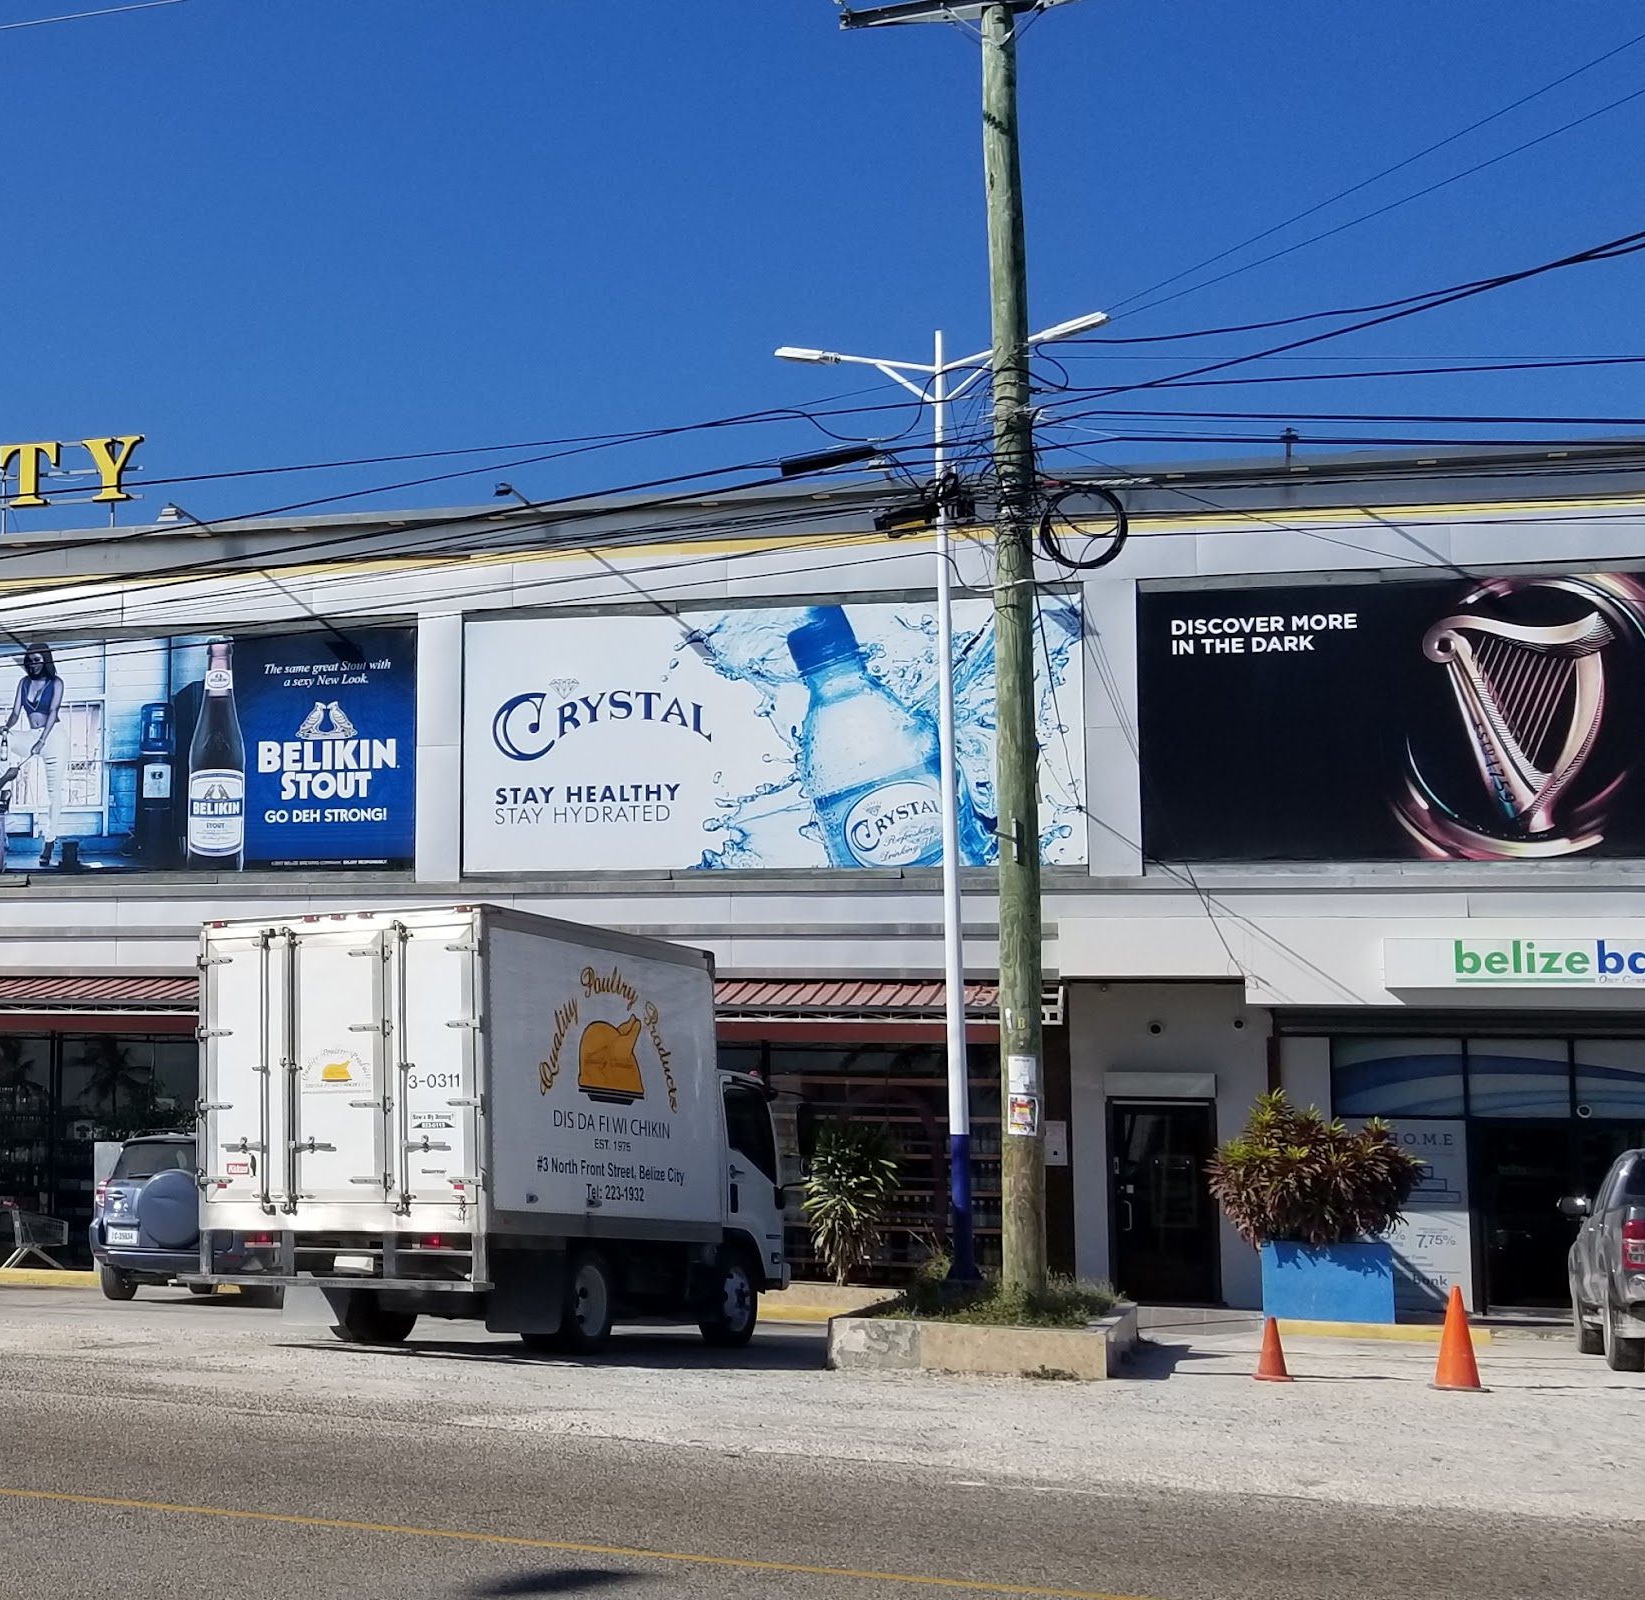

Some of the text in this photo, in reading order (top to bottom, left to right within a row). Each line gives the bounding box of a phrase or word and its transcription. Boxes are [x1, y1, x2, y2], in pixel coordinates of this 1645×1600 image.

[1171, 613, 1358, 636] DISCOVER MORE
[1172, 634, 1315, 655] IN THE DARK
[264, 659, 391, 675] The same great Stout with
[283, 673, 369, 688] a sexy New Look.
[492, 690, 712, 761] CRYSTAL
[257, 738, 400, 773] BELIKIN
[281, 771, 372, 800] STOUT
[495, 783, 681, 804] STAY HEALTHY
[192, 801, 240, 815] BELIKIN
[264, 808, 387, 823] GO DEH STRONG!
[494, 804, 670, 825] STAY HYDRATED
[1454, 940, 1590, 974] belize
[539, 966, 678, 1114] Quality Poultry Products
[553, 1109, 671, 1140] DIS DA FI WI CHIKIN
[594, 1138, 611, 1150] EST.
[537, 1156, 685, 1187] #3 North Front Street, Belize City
[586, 1183, 645, 1202] Tel: 223-1932
[1415, 1234, 1456, 1249] 7.75%
